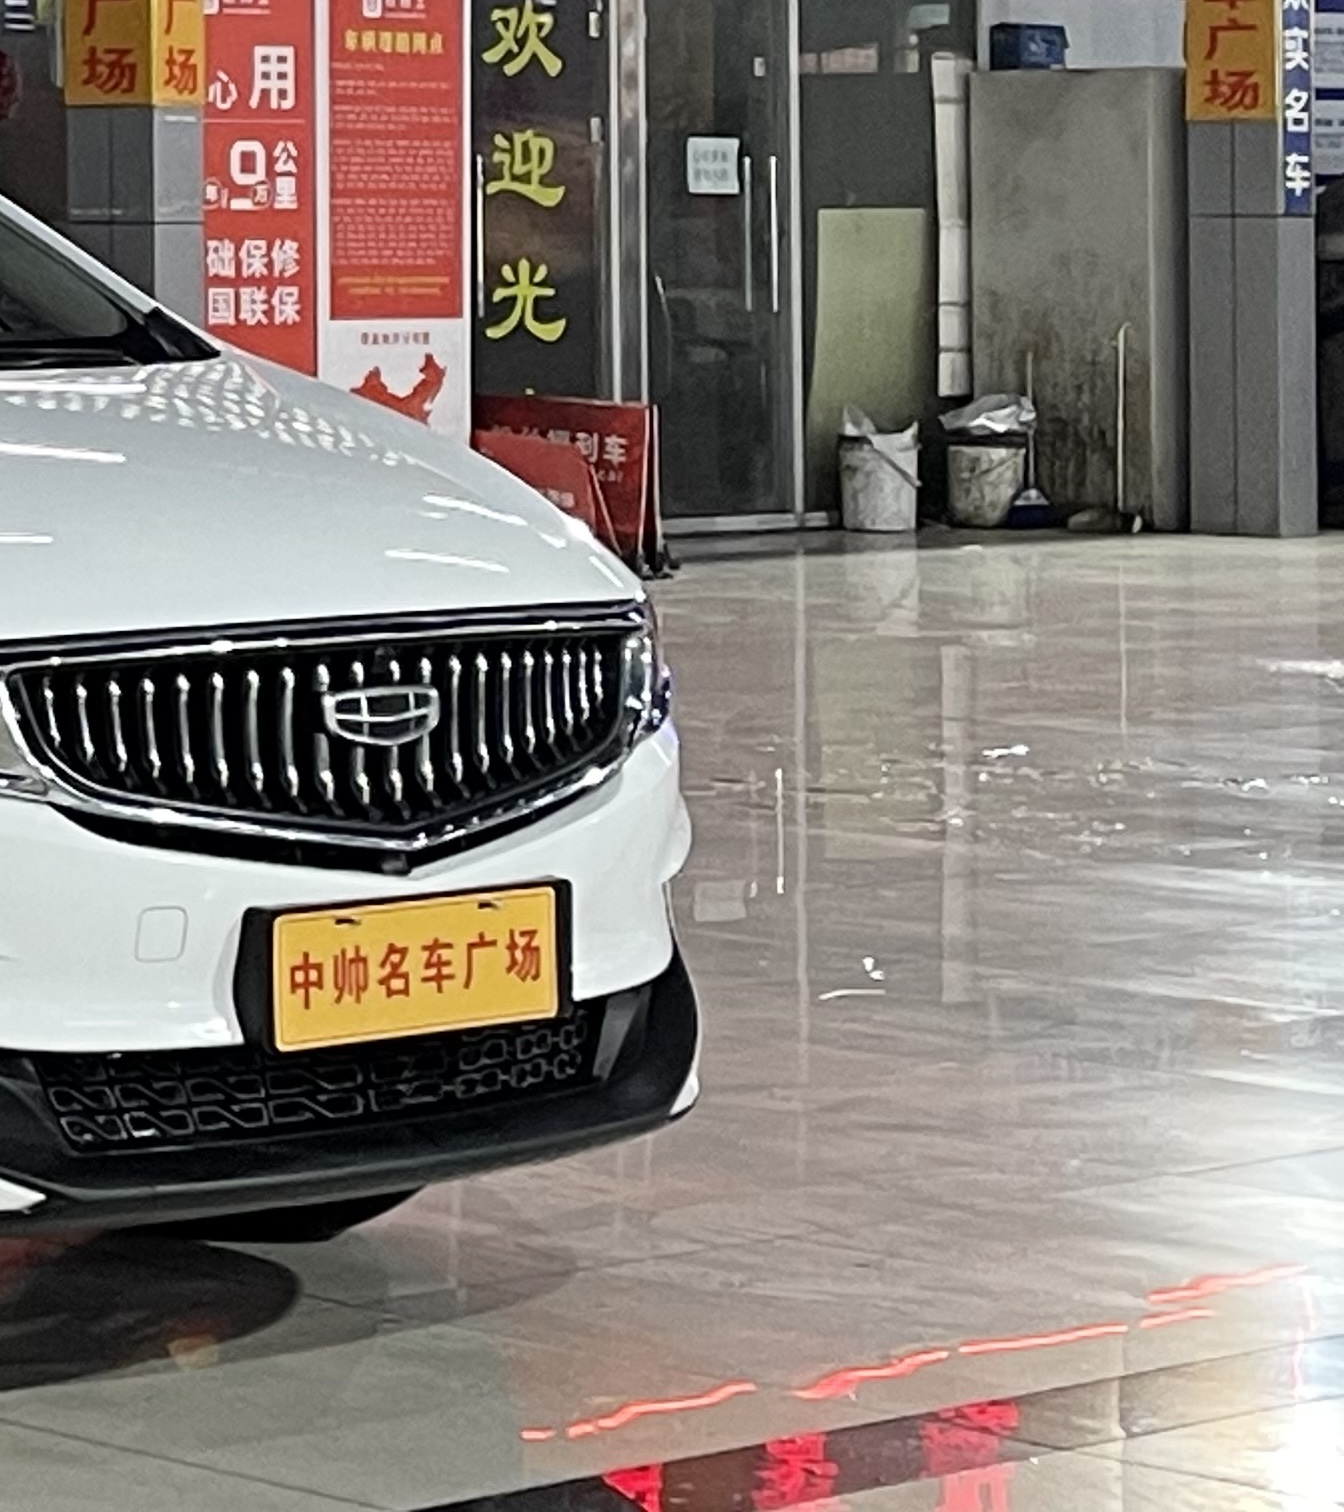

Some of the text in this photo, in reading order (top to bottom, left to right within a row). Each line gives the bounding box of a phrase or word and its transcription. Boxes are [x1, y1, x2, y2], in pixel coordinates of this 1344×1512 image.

[289, 927, 542, 1010] 中帅名车广场
